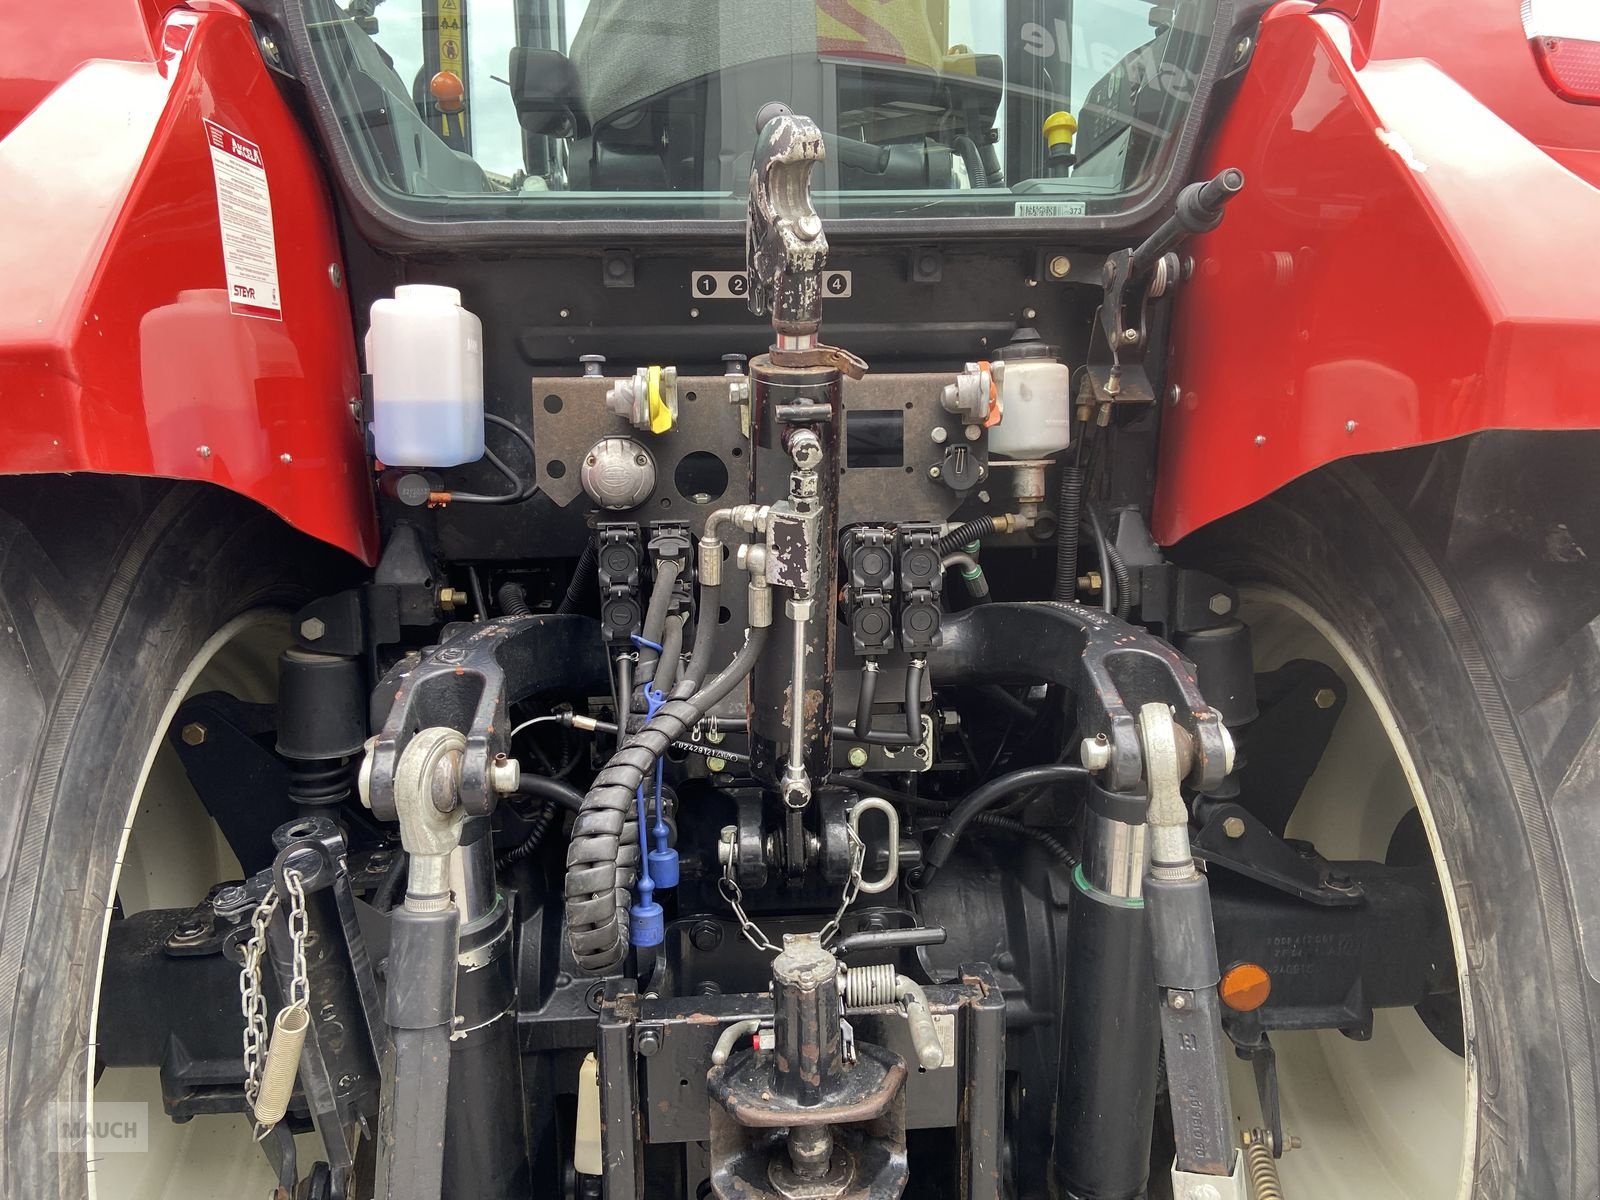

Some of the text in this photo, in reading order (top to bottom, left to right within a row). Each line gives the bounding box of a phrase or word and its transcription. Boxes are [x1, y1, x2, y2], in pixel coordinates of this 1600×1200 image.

[703, 278, 842, 291] 1 2 4
[233, 284, 256, 300] STEYR
